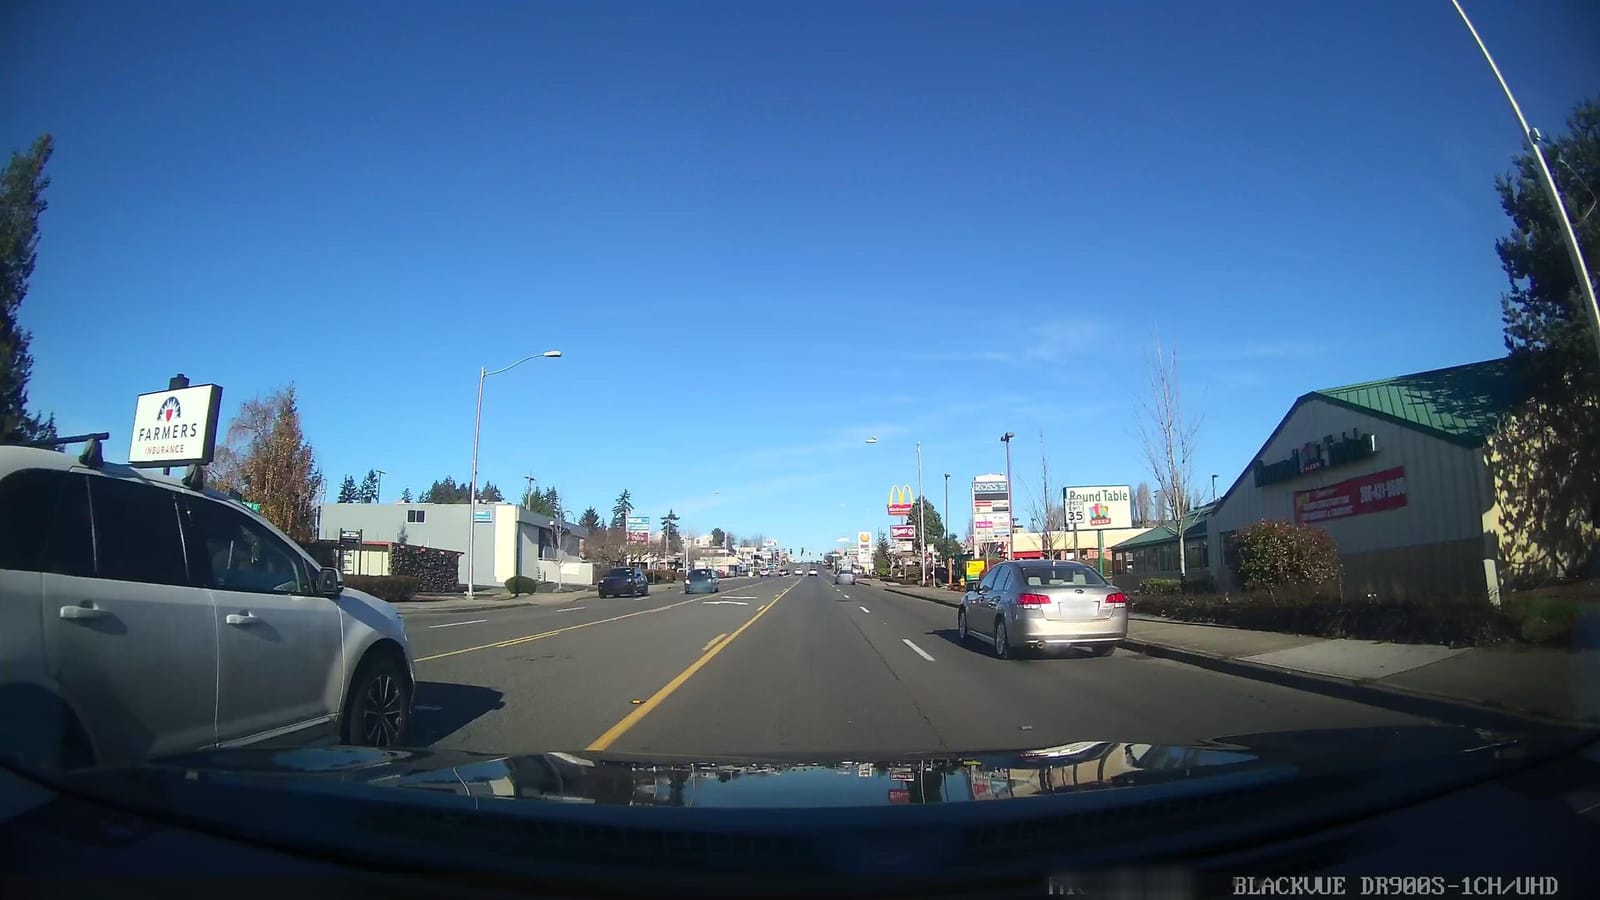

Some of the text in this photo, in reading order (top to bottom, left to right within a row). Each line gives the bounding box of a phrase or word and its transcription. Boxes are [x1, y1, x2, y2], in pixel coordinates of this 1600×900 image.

[138, 423, 197, 442] FARMERS
[145, 444, 184, 455] INSURANCE
[975, 483, 999, 491] ROSS
[1069, 489, 1128, 502] Round Table
[1068, 511, 1083, 521] 35
